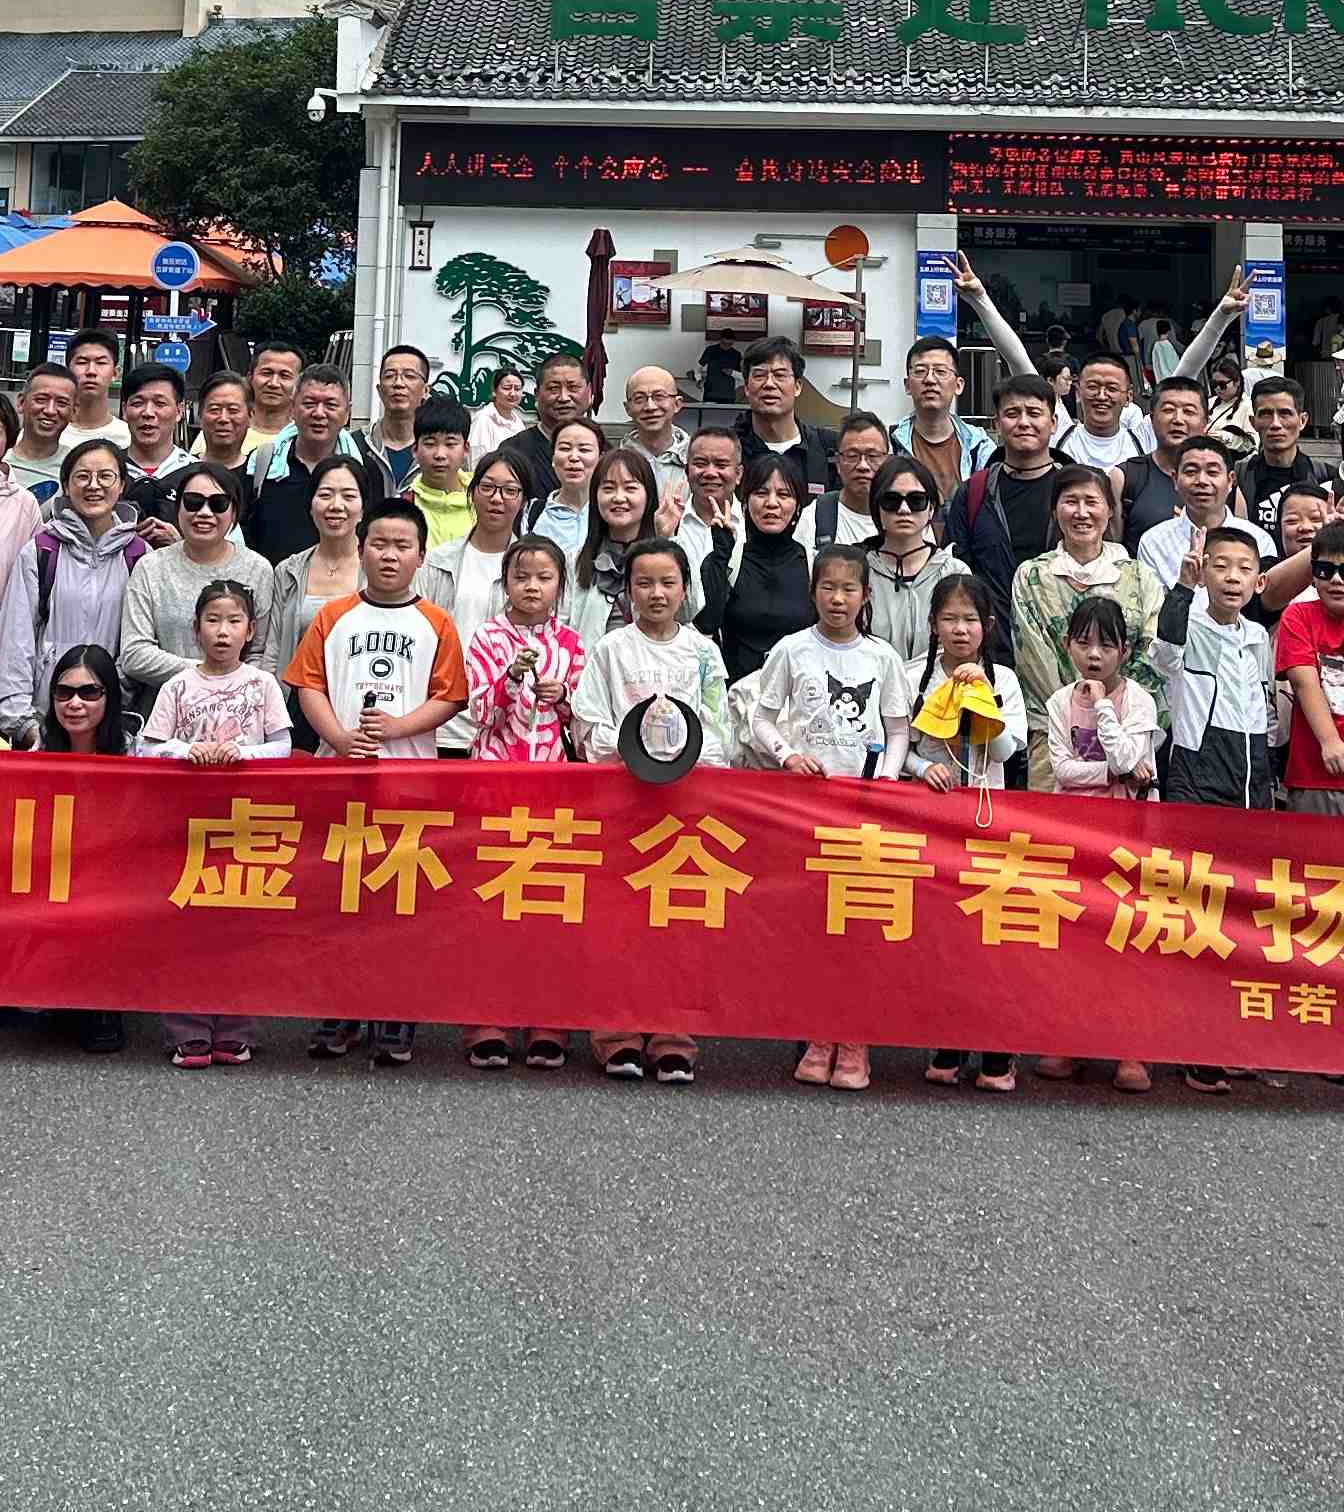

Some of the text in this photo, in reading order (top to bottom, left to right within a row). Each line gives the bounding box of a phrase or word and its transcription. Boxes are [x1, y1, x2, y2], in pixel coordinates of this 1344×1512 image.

[348, 631, 417, 662] LOOK
[167, 797, 753, 929] 虚怀若谷
